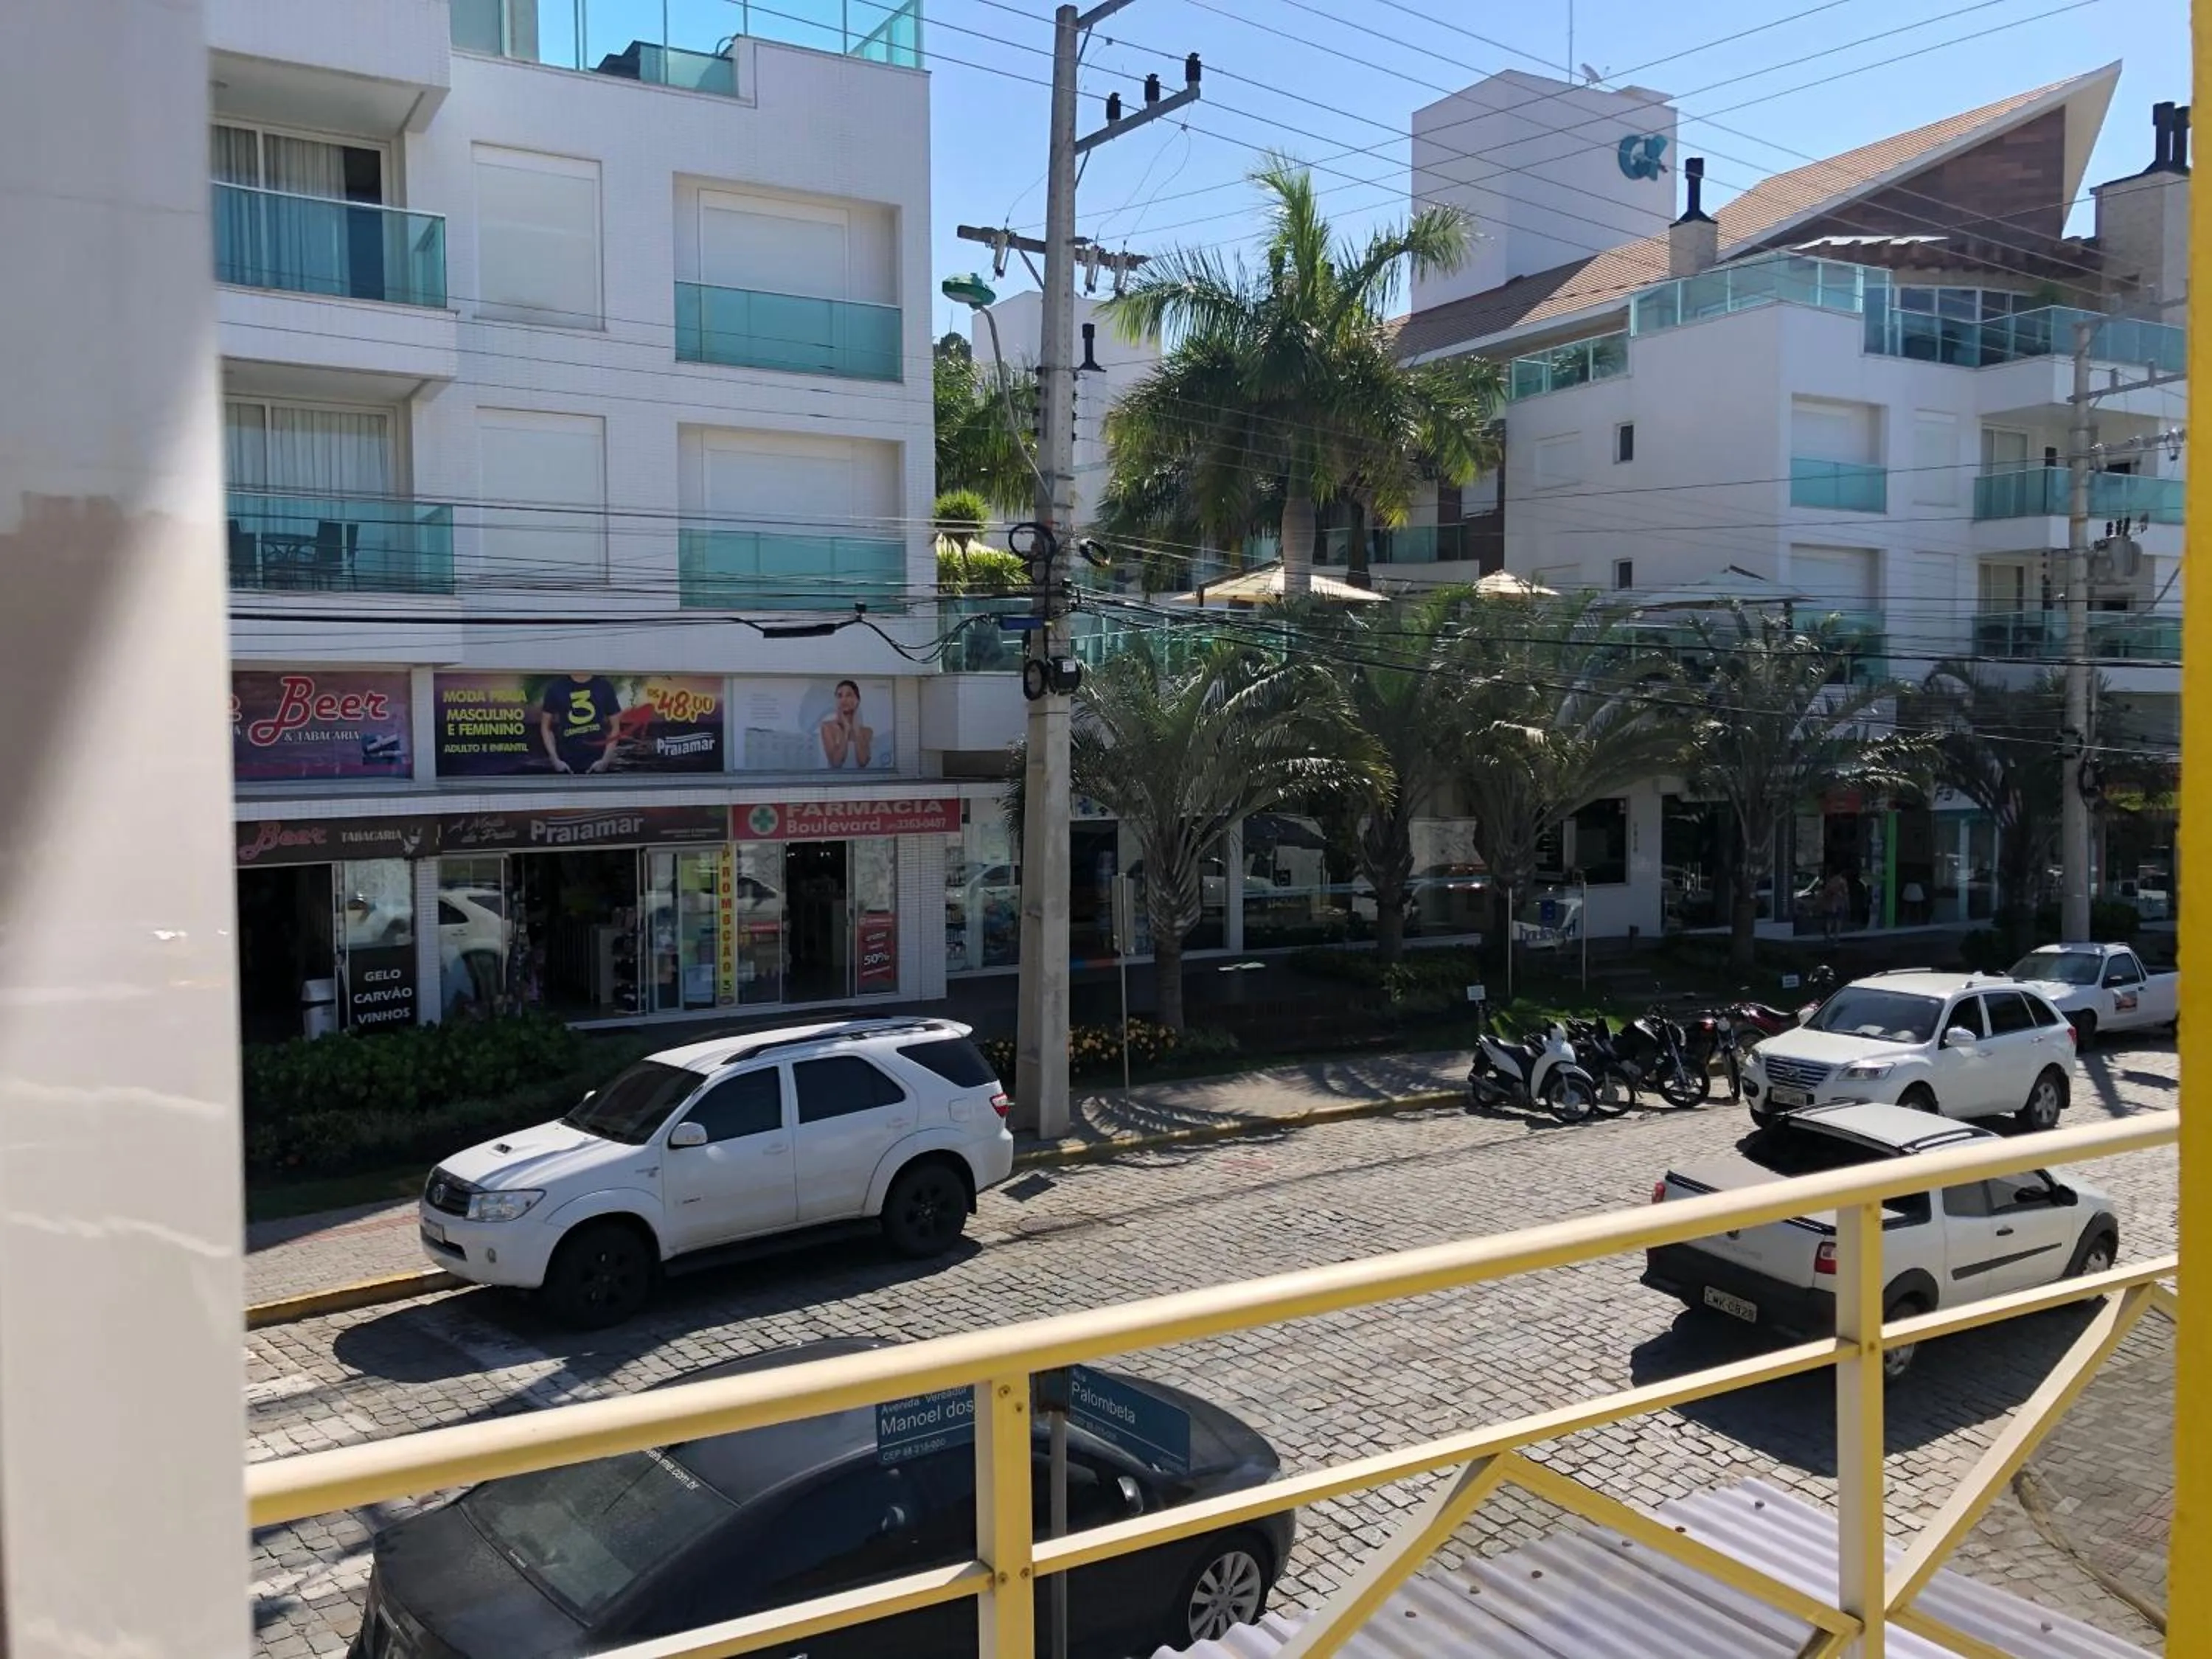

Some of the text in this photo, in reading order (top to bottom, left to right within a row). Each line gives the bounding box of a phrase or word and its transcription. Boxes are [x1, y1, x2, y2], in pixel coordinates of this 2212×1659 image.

[443, 690, 485, 703] MODA
[248, 676, 389, 746] Beer
[446, 709, 525, 720] MASCULINO
[568, 689, 596, 725] 3
[657, 690, 714, 722] 48,00
[299, 730, 361, 742] TABACARIA
[448, 723, 525, 736] E FEMININO
[444, 742, 529, 753] ADULTO E INFANTIL
[787, 817, 881, 834] Boulevard
[238, 821, 327, 860] Beer
[341, 830, 403, 843] TABACARIA
[863, 952, 890, 965] 50%
[364, 969, 401, 981] GELO
[358, 1007, 411, 1024] VINHOS
[881, 1398, 920, 1415] Avenida
[1071, 1381, 1135, 1425] Palombeta
[881, 1399, 974, 1437] Manoel dos
